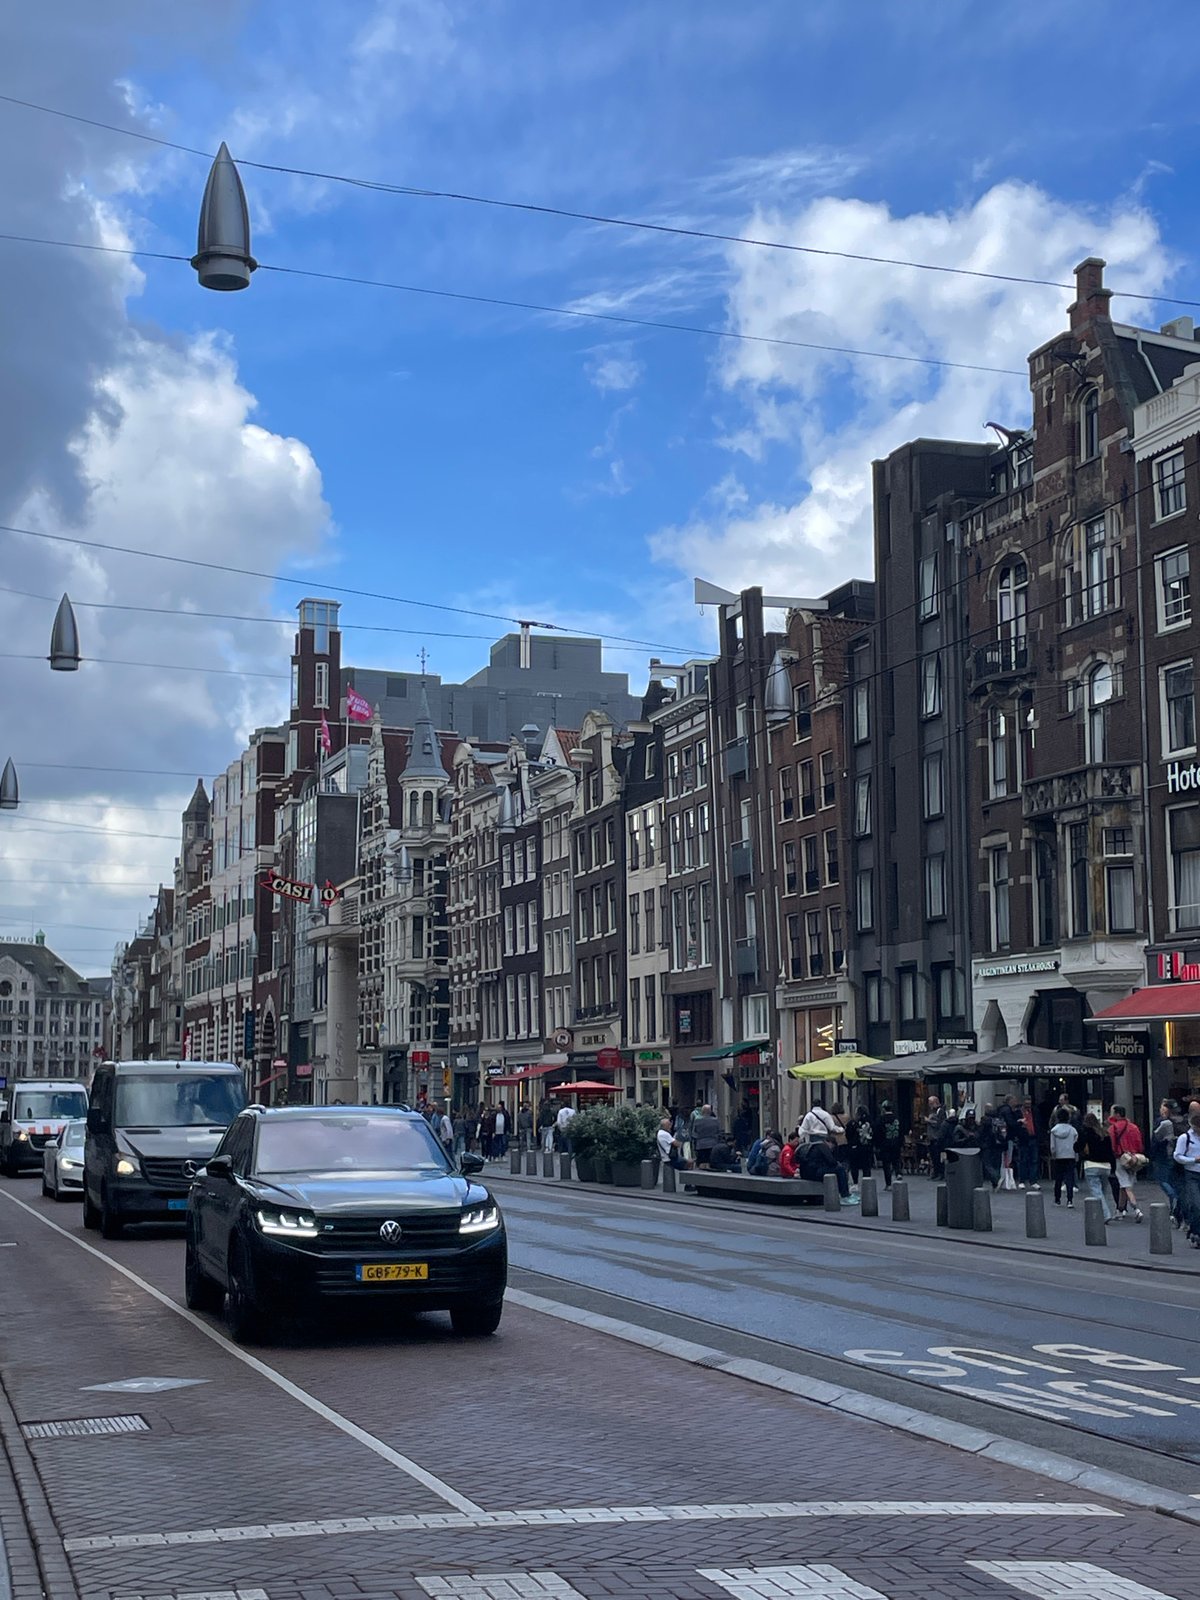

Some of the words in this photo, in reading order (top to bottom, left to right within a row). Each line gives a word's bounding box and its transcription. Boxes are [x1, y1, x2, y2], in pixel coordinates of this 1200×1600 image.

[272, 878, 335, 900] CASIO
[1017, 961, 1056, 973] STEAKHOUSE
[1114, 1034, 1134, 1044] Hotel
[1000, 1065, 1032, 1073] LUNCH
[1035, 1065, 1041, 1073] &
[1043, 1065, 1105, 1075] STEAKHOUSE
[366, 1265, 423, 1279] GBF-79-K
[843, 1343, 1186, 1378] BUS
